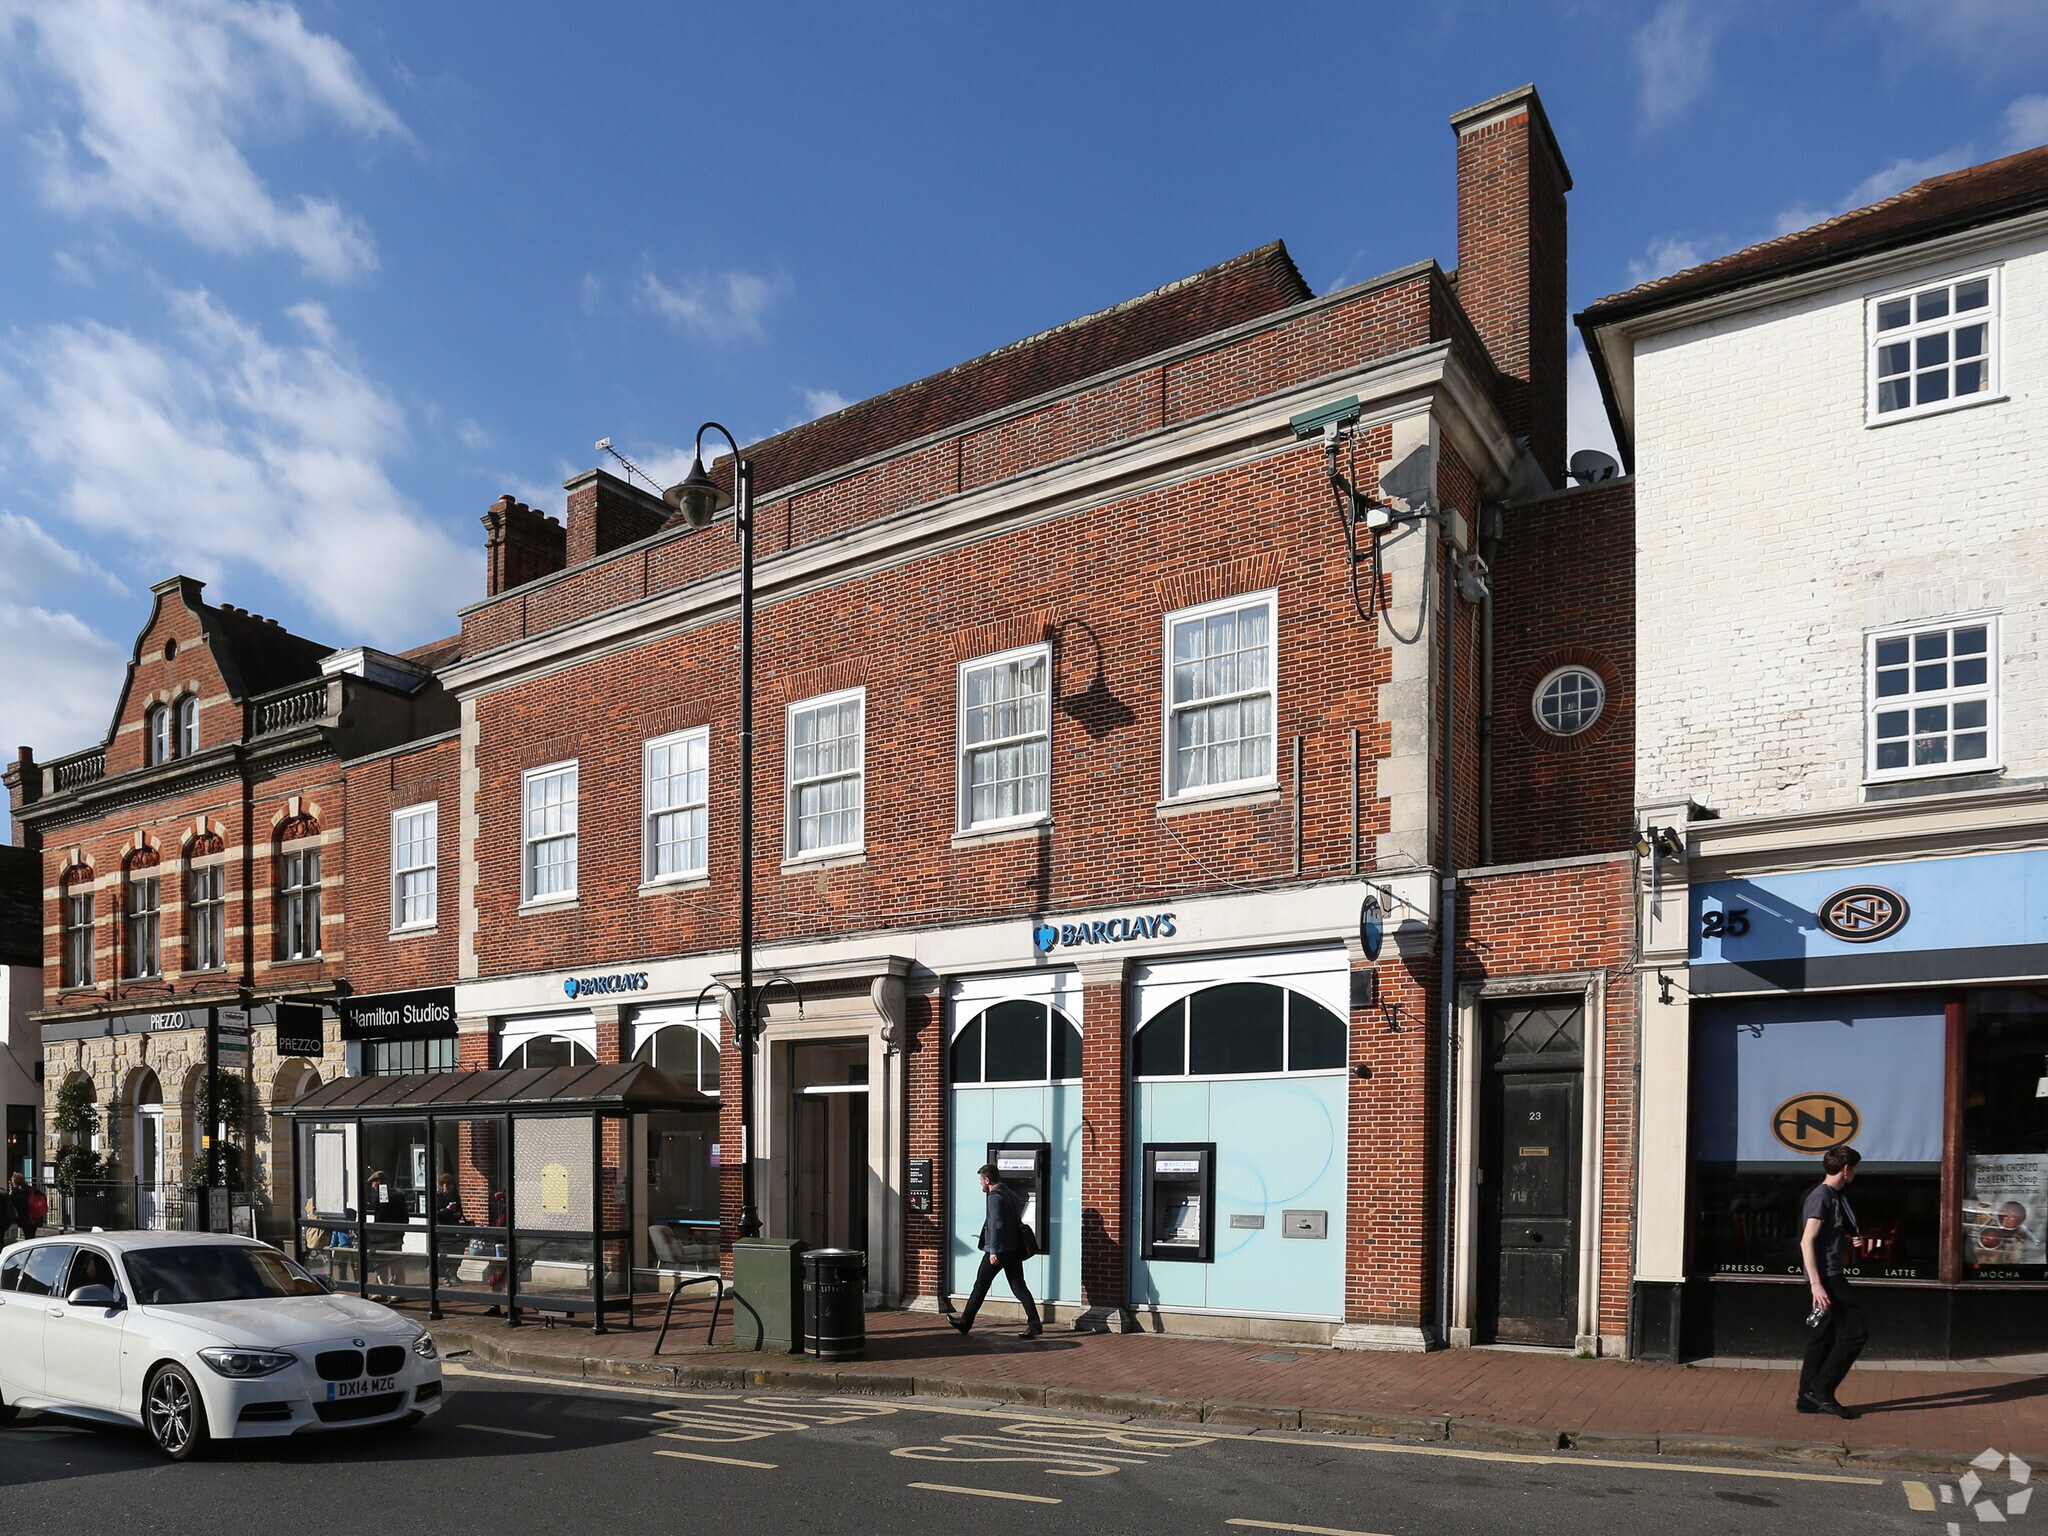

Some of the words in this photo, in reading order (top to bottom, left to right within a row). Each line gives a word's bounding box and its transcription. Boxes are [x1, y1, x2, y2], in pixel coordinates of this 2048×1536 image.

[1061, 912, 1177, 947] BARCLAYS
[1702, 908, 1750, 939] 25
[579, 971, 649, 996] BARCLAYS
[150, 1011, 184, 1030] PREZZO
[350, 1007, 400, 1027] Hamilton
[403, 1003, 450, 1024] Studios
[279, 1037, 322, 1052] PREZZO
[1529, 1112, 1541, 1120] 23
[1976, 1163, 2004, 1173] Spanish
[2006, 1162, 2038, 1172] CHORIZO
[2018, 1174, 2038, 1185] Soup
[1713, 1263, 1765, 1273] SPRESSO
[1885, 1269, 1916, 1277] LATTE
[1979, 1271, 2020, 1279] MOCHA
[339, 1381, 368, 1397] DX14
[371, 1377, 395, 1392] MZG
